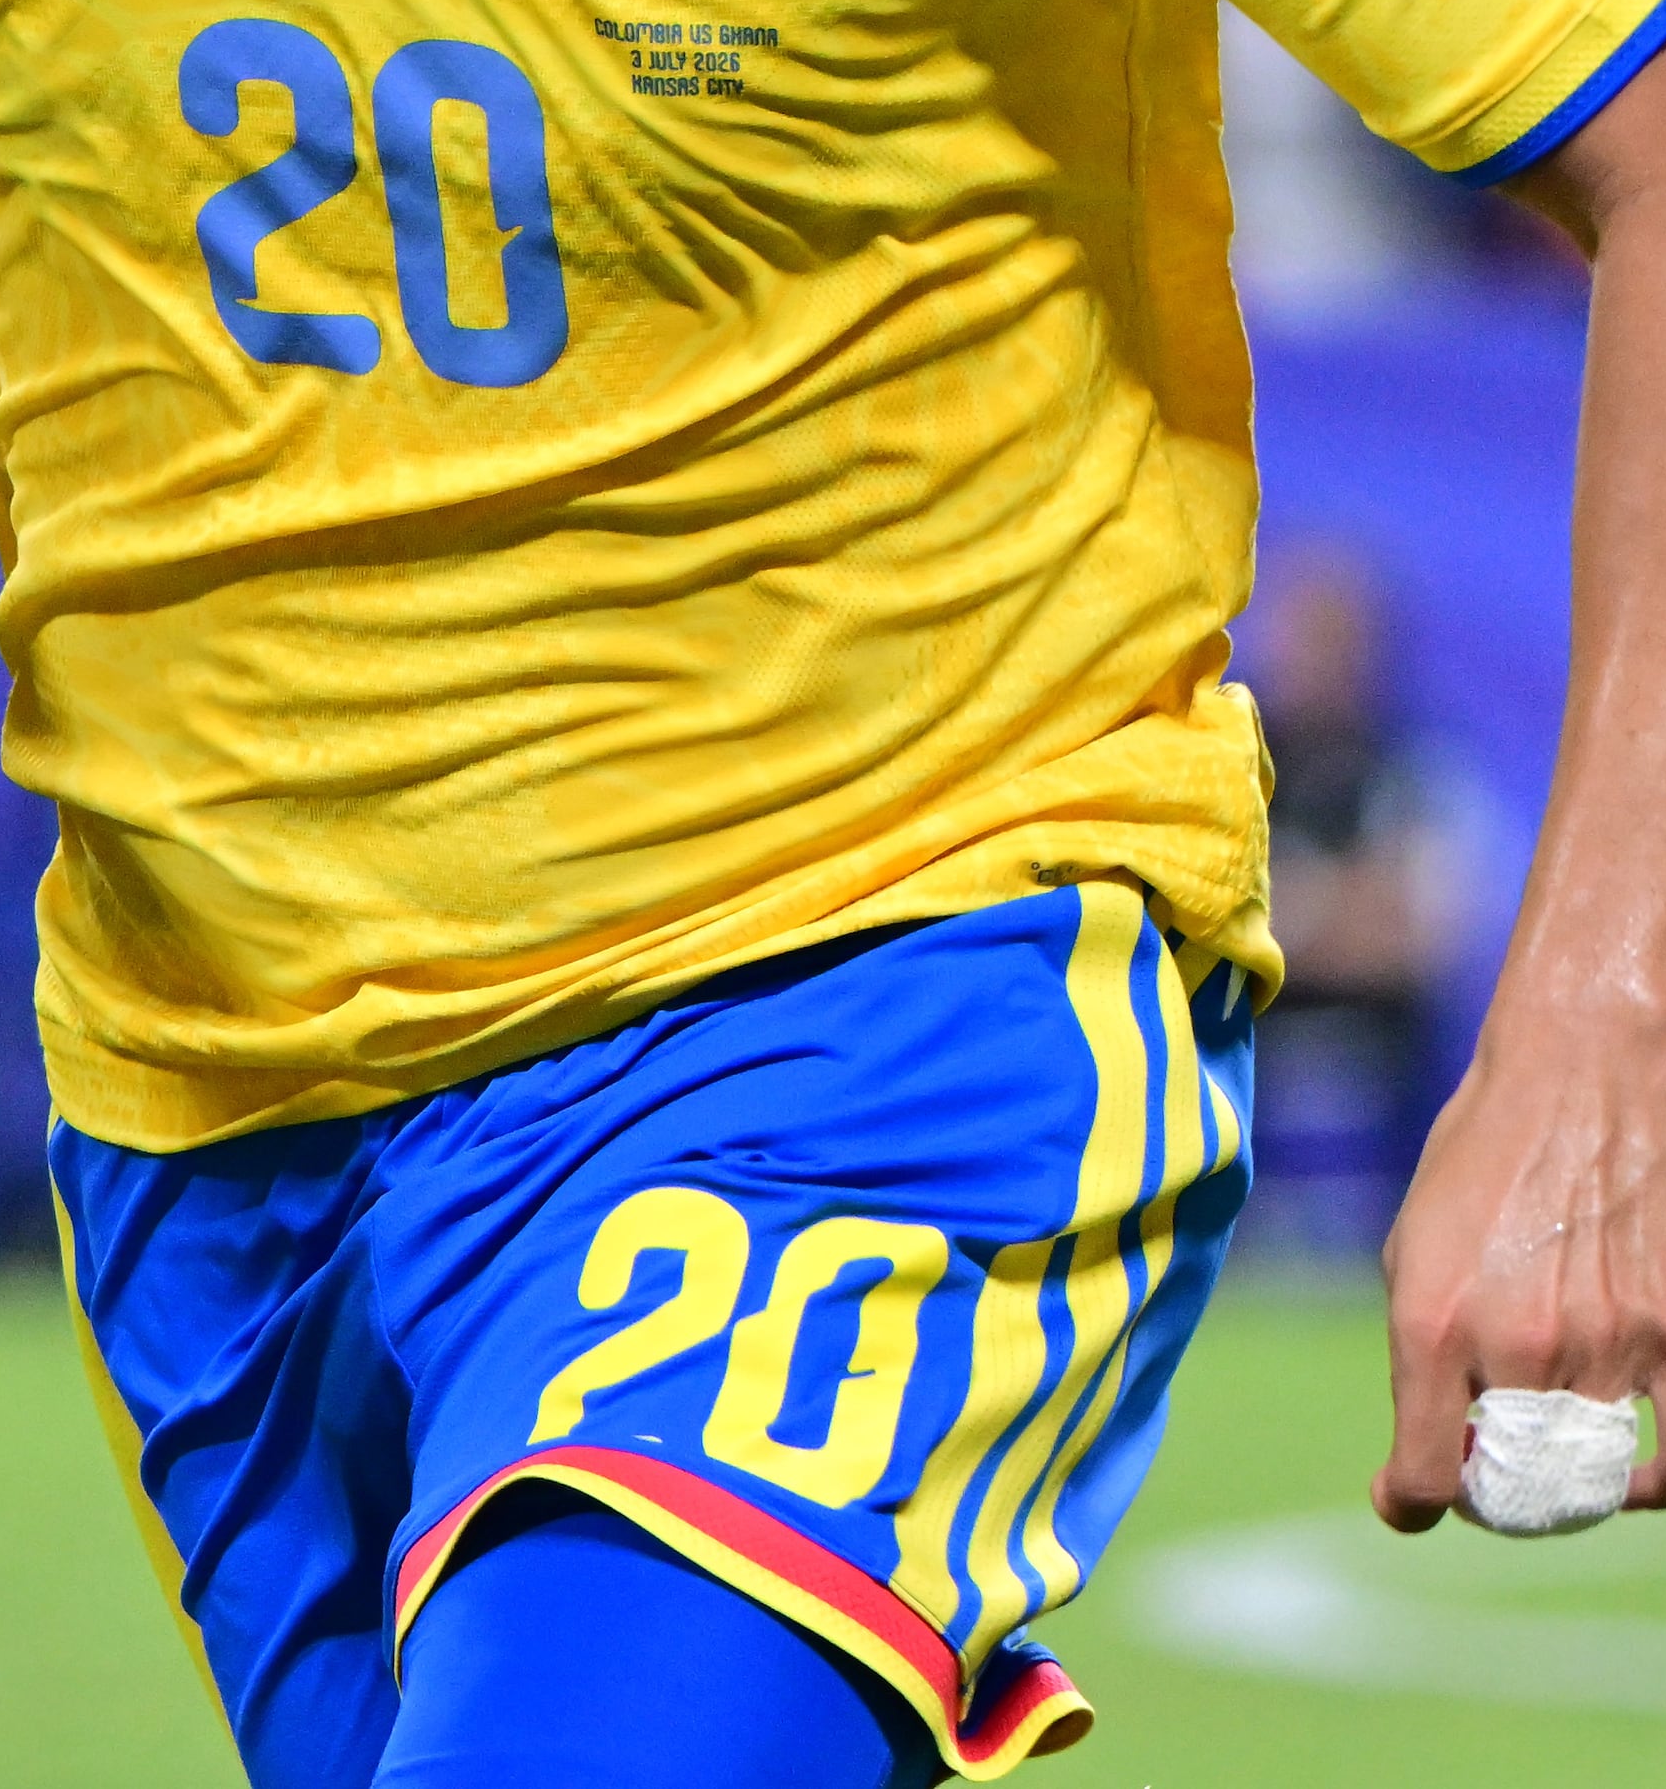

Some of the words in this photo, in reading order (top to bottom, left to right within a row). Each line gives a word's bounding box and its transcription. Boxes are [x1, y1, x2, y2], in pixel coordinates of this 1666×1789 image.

[594, 18, 683, 45] COLOMBIA
[719, 24, 779, 47] GHANA
[630, 50, 642, 68] 3
[648, 51, 687, 71] JULY
[693, 52, 741, 73] 2026
[631, 74, 700, 97] KANSAS
[706, 77, 745, 97] CITY
[178, 18, 569, 388] 20
[527, 1187, 949, 1510] 20
